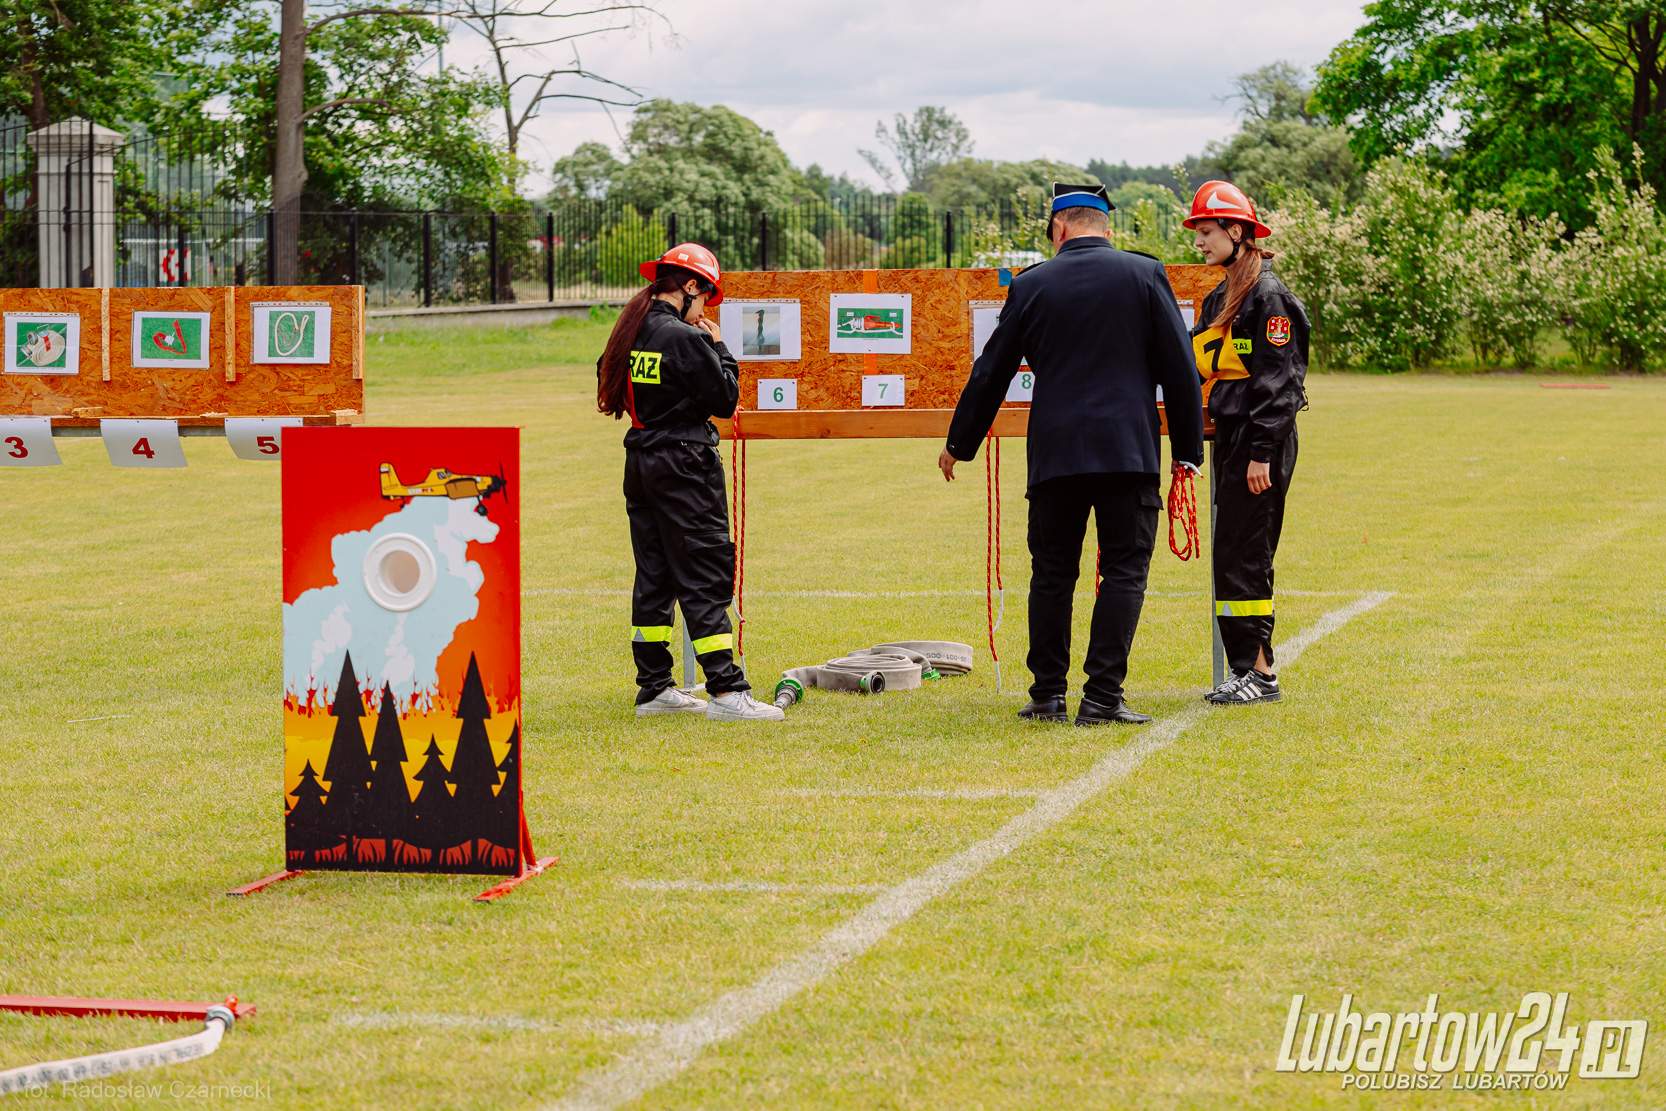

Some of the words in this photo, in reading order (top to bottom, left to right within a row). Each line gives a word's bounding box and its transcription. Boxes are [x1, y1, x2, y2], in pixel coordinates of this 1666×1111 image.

[1203, 336, 1225, 373] 7
[1021, 373, 1032, 389] 8
[773, 386, 784, 402] 6
[877, 383, 889, 399] 7
[4, 436, 29, 459] 3
[131, 437, 155, 459] 4
[256, 436, 280, 455] 5
